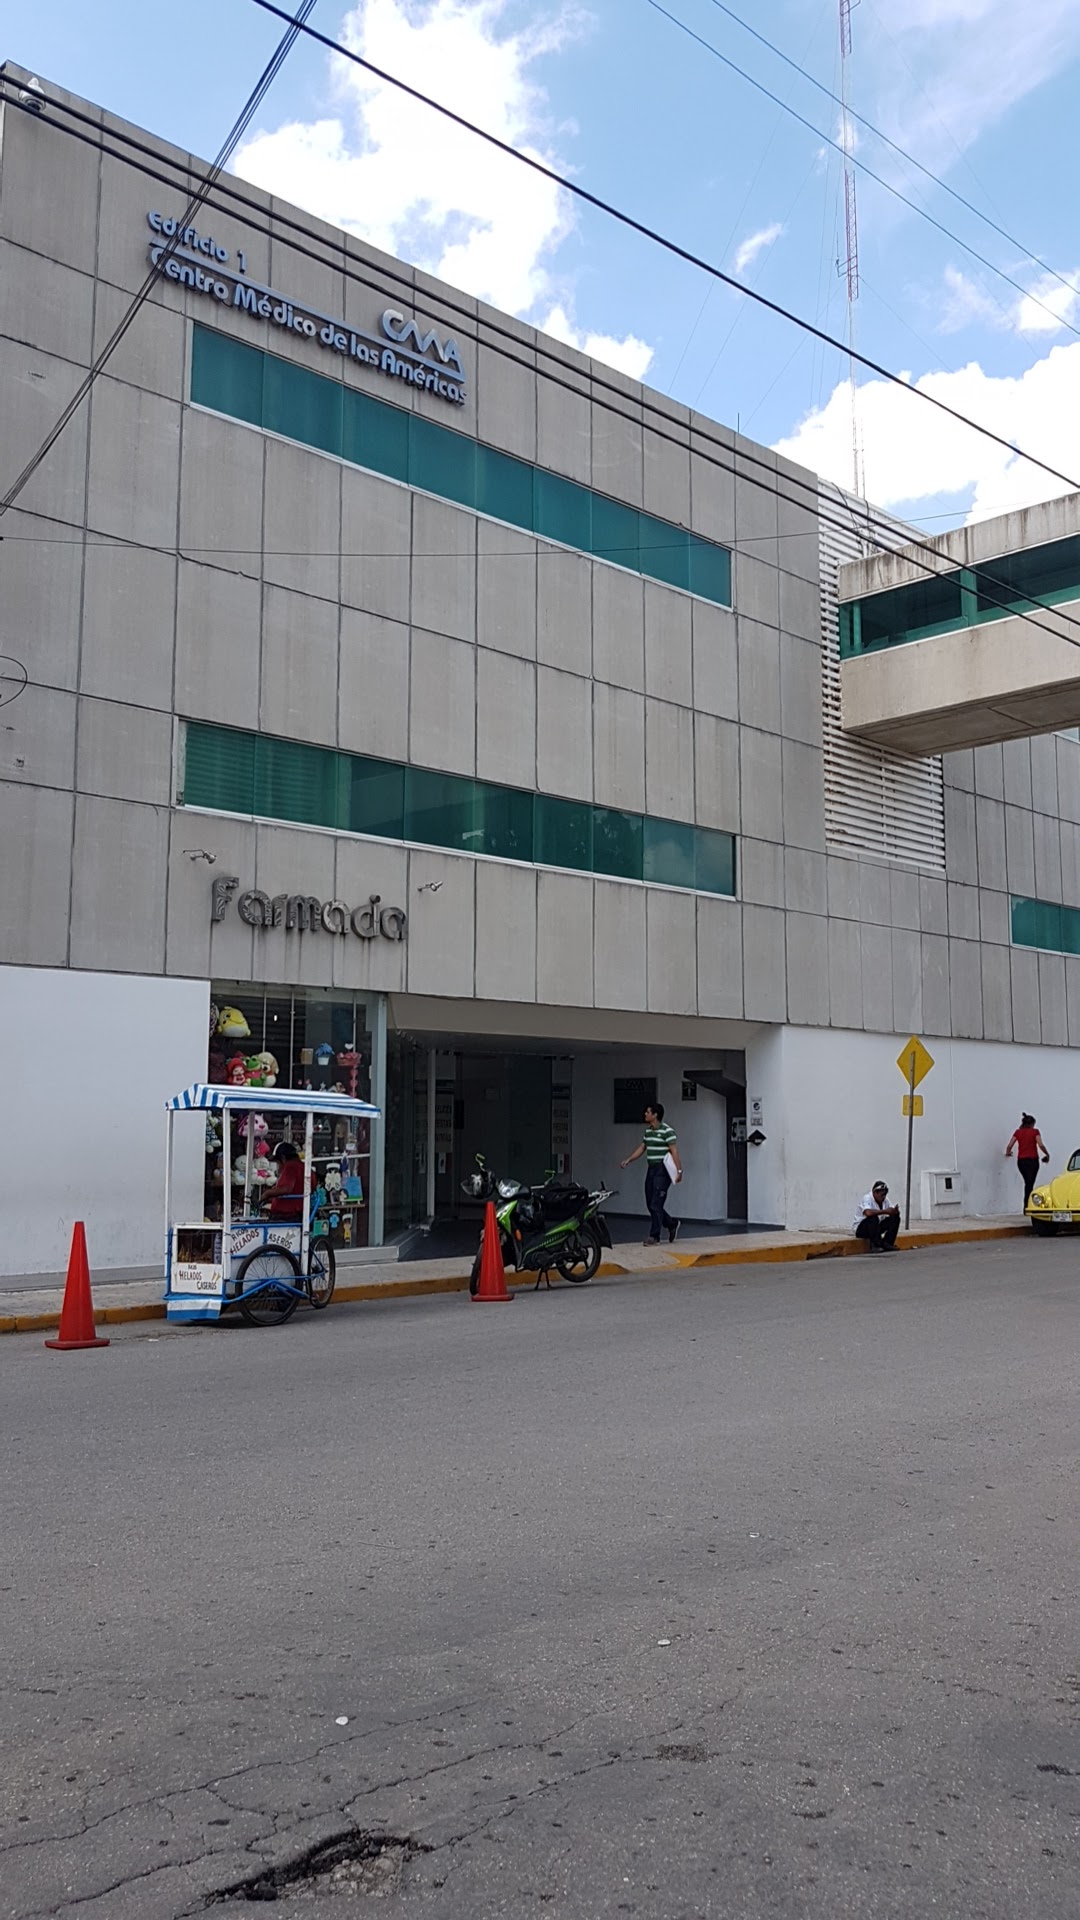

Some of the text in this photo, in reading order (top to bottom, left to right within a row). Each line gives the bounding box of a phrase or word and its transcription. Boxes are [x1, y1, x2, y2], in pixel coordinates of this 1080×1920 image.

[151, 247, 468, 403] Centro Médico de las Américas
[211, 876, 408, 941] Farmacia
[230, 1228, 260, 1255] HELADOS
[231, 1227, 249, 1242] RICOS
[265, 1232, 293, 1249] ASEROS
[179, 1270, 203, 1281] HELADOS
[196, 1281, 218, 1291] CASEROS
